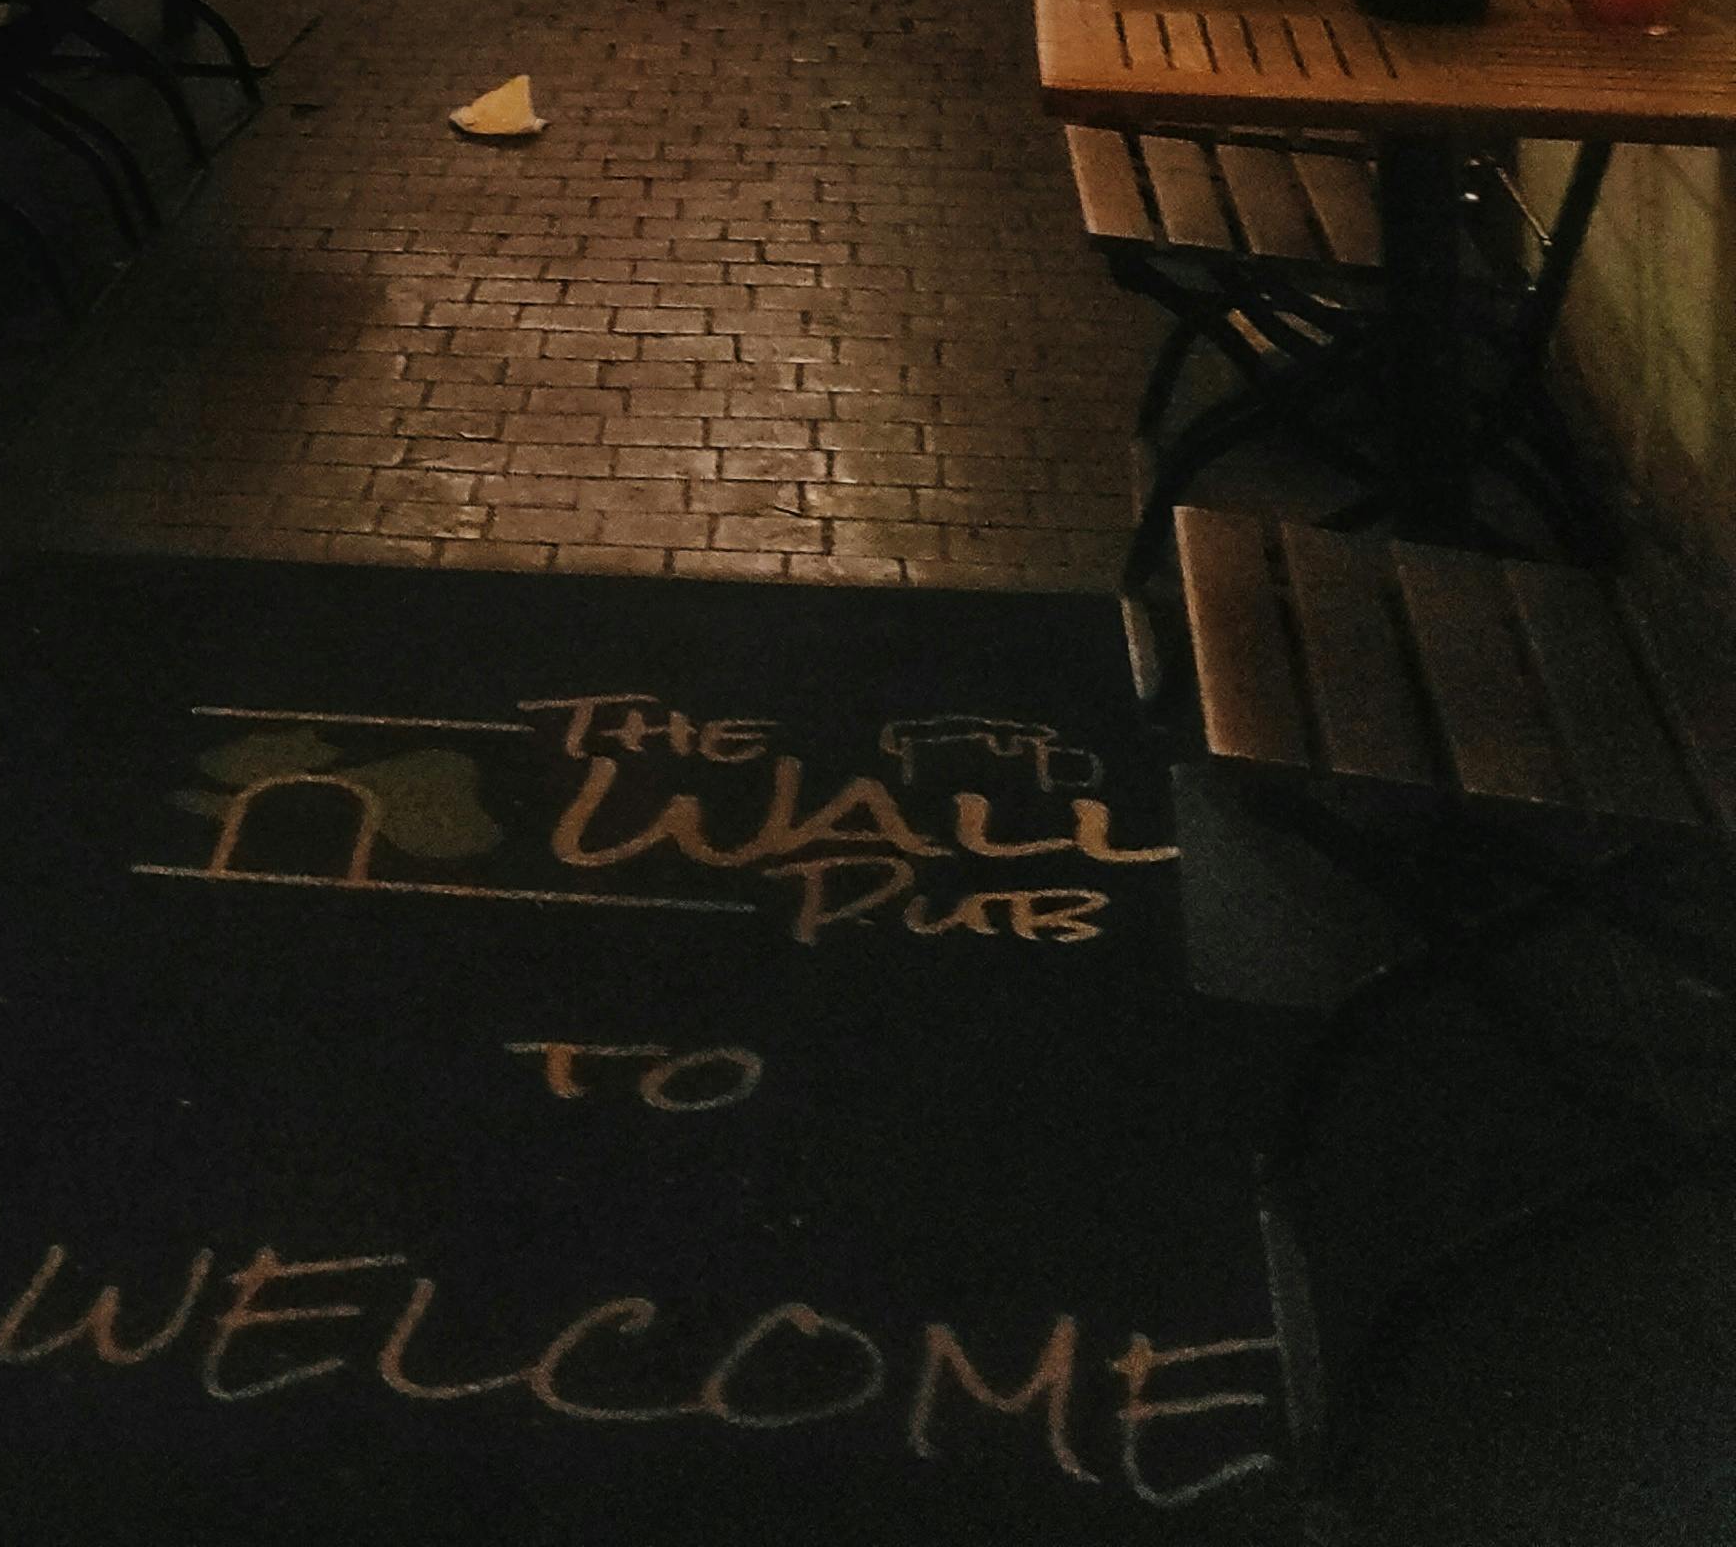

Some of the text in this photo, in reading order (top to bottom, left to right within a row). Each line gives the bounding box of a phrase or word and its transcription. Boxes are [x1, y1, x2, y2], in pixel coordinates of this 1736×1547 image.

[518, 693, 780, 763] THE
[551, 755, 1181, 868] WALL
[504, 1041, 764, 1110] TO
